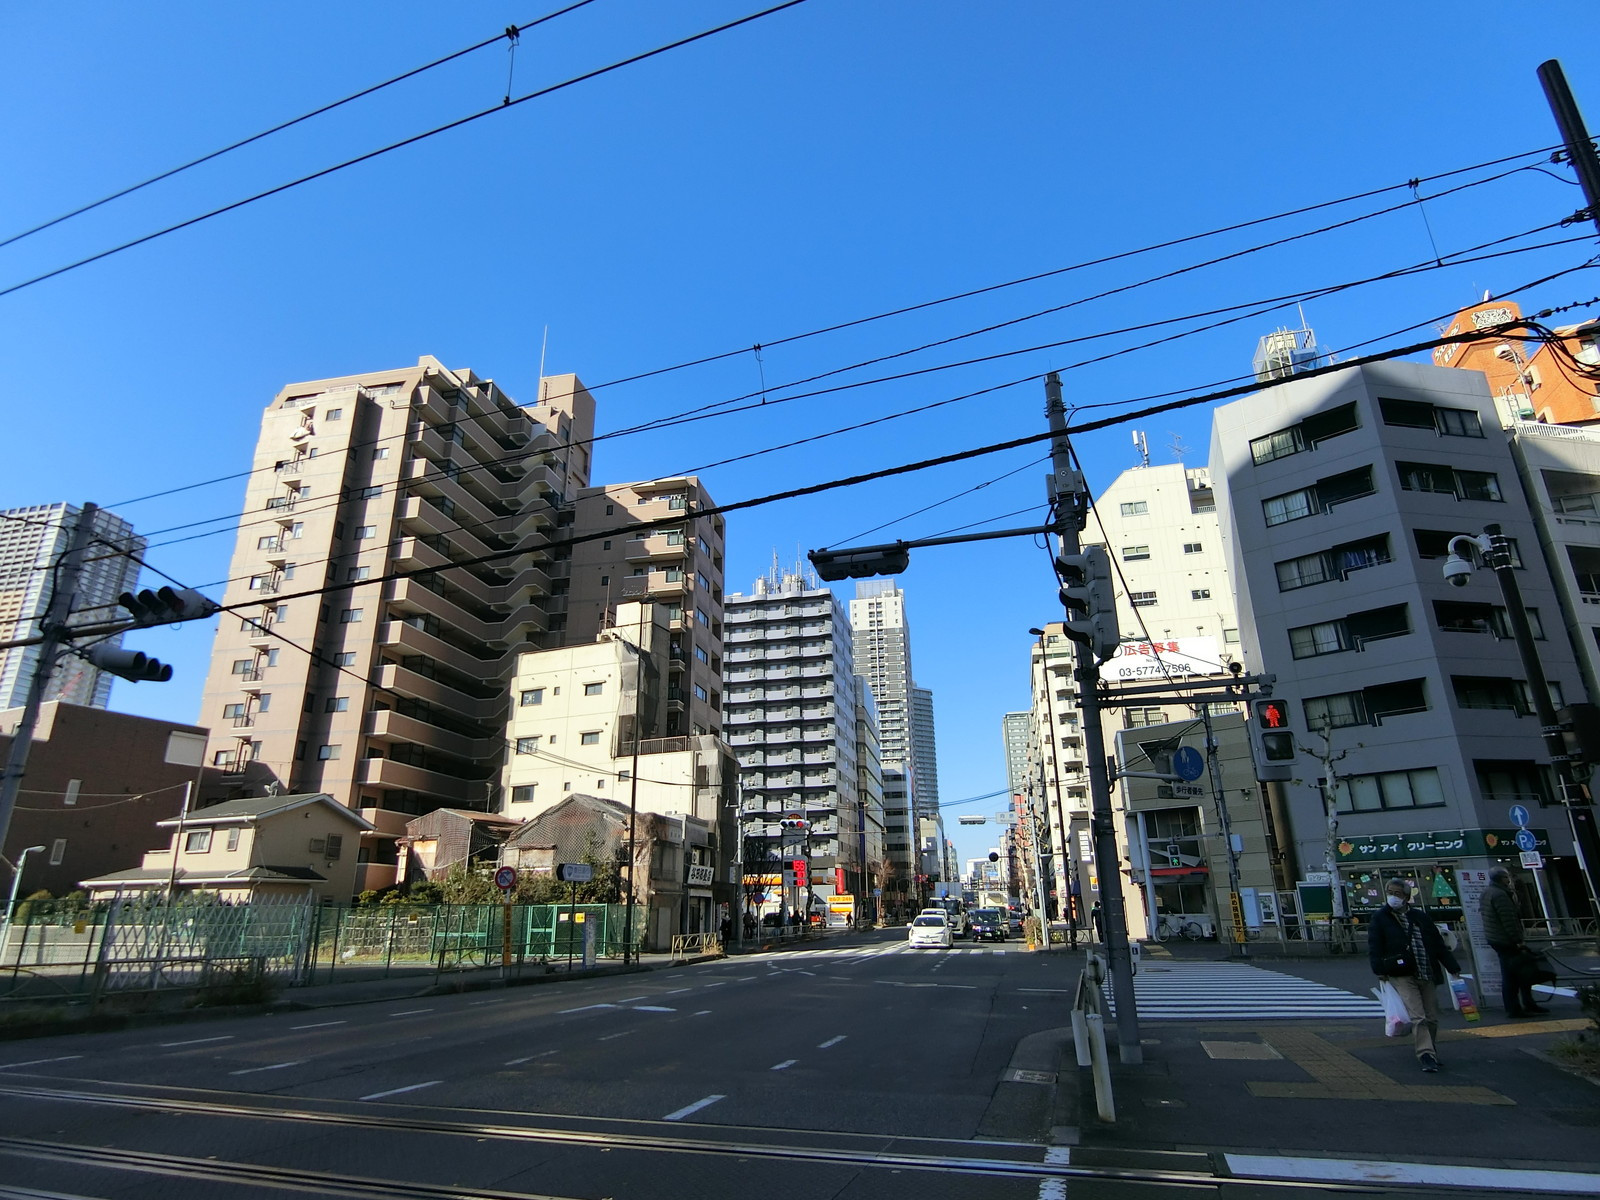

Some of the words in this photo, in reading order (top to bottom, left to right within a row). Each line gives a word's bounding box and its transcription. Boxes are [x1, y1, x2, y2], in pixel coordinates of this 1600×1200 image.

[1359, 844, 1377, 853] サン
[1380, 843, 1398, 852] アイ
[1407, 840, 1463, 851] クリーニング
